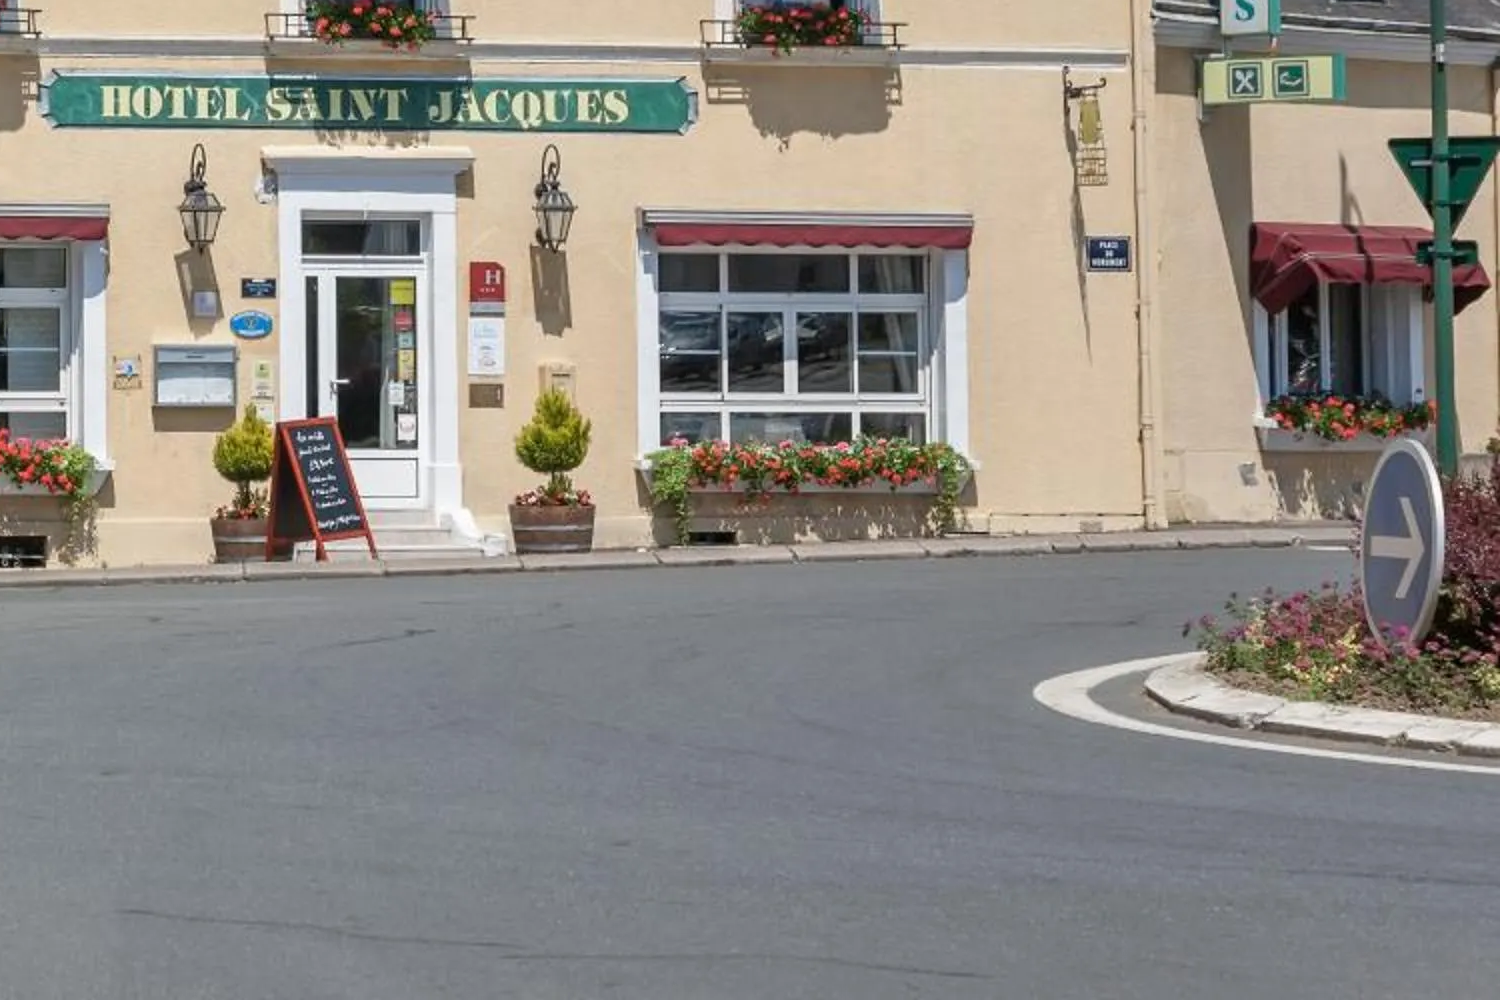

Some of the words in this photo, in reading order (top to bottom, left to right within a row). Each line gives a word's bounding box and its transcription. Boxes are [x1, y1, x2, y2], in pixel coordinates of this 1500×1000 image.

[100, 84, 251, 121] HOTEL
[265, 86, 408, 122] SAINT
[428, 88, 630, 129] JACQUES
[484, 269, 501, 285] H
